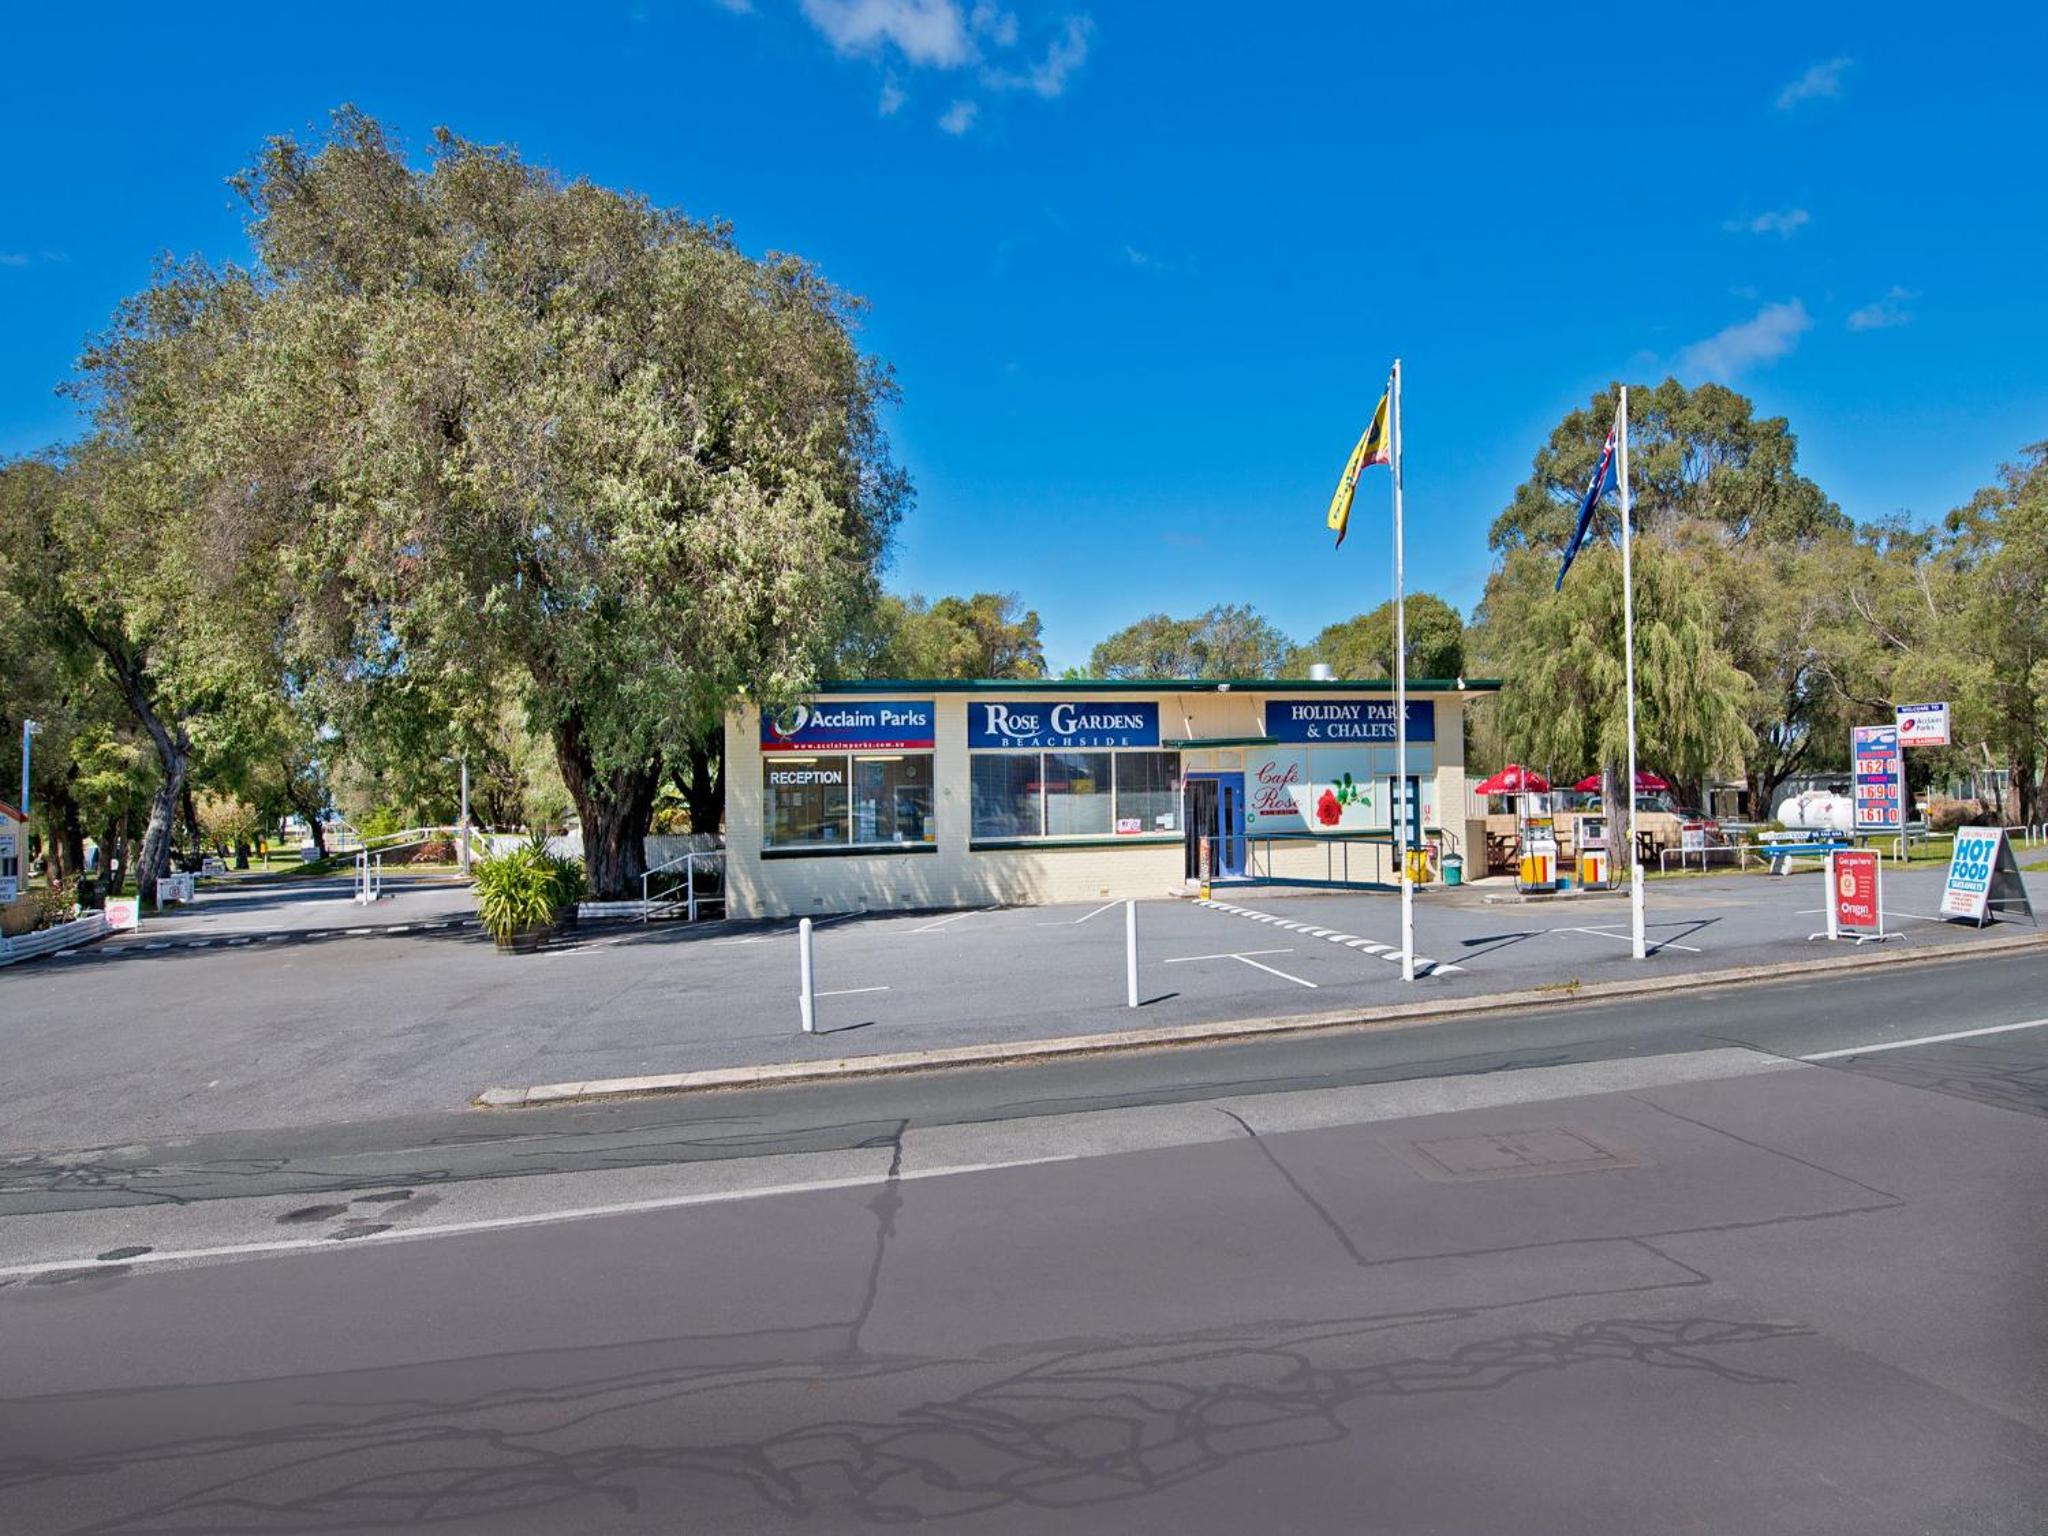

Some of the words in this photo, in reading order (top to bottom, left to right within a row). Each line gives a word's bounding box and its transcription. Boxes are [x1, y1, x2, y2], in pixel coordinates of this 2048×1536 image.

[810, 710, 875, 728] Acclaim
[880, 709, 927, 727] Parks
[1292, 705, 1361, 720] HOLIDAY
[1307, 723, 1321, 738] &
[1327, 722, 1397, 738] CHALETS
[1001, 737, 1129, 747] BEACHSIDE
[770, 770, 842, 785] RECEPTION
[1956, 839, 1995, 862] HOT
[1951, 861, 1989, 880] FOOD
[1841, 902, 1869, 916] Origin
